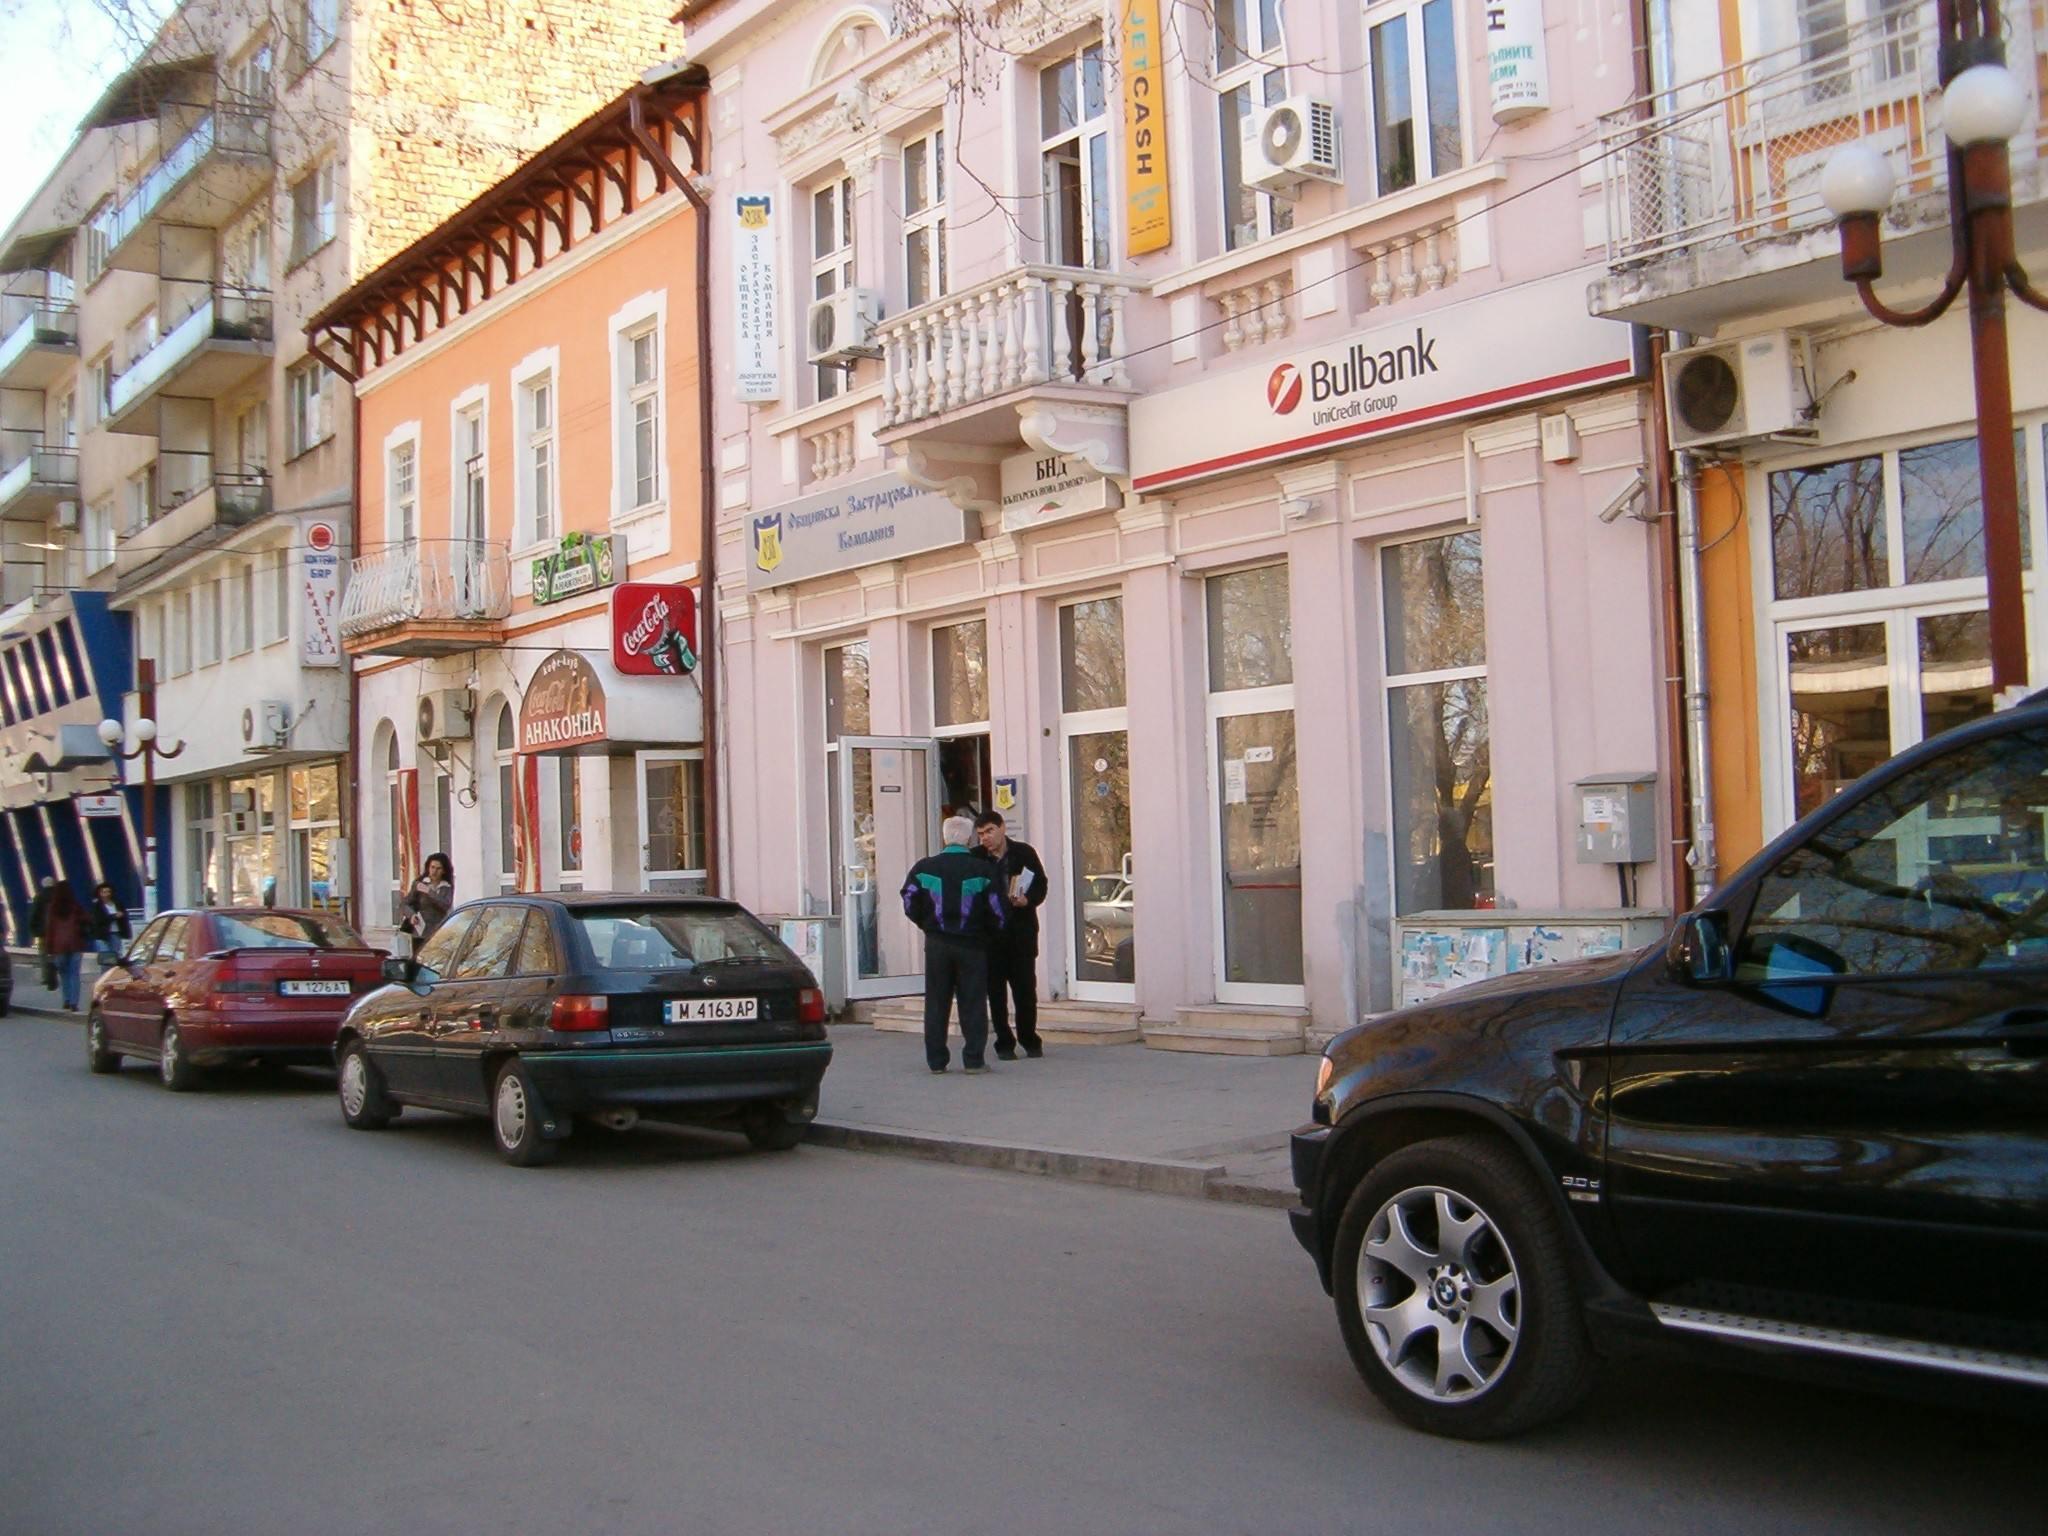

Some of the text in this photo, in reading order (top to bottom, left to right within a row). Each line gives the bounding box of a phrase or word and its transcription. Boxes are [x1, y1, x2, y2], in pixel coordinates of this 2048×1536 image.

[1133, 76, 1152, 175] CASH
[1310, 327, 1438, 402] Bulbank
[1312, 394, 1398, 426] UniCredit Group
[526, 709, 604, 745] АНАКОНДА
